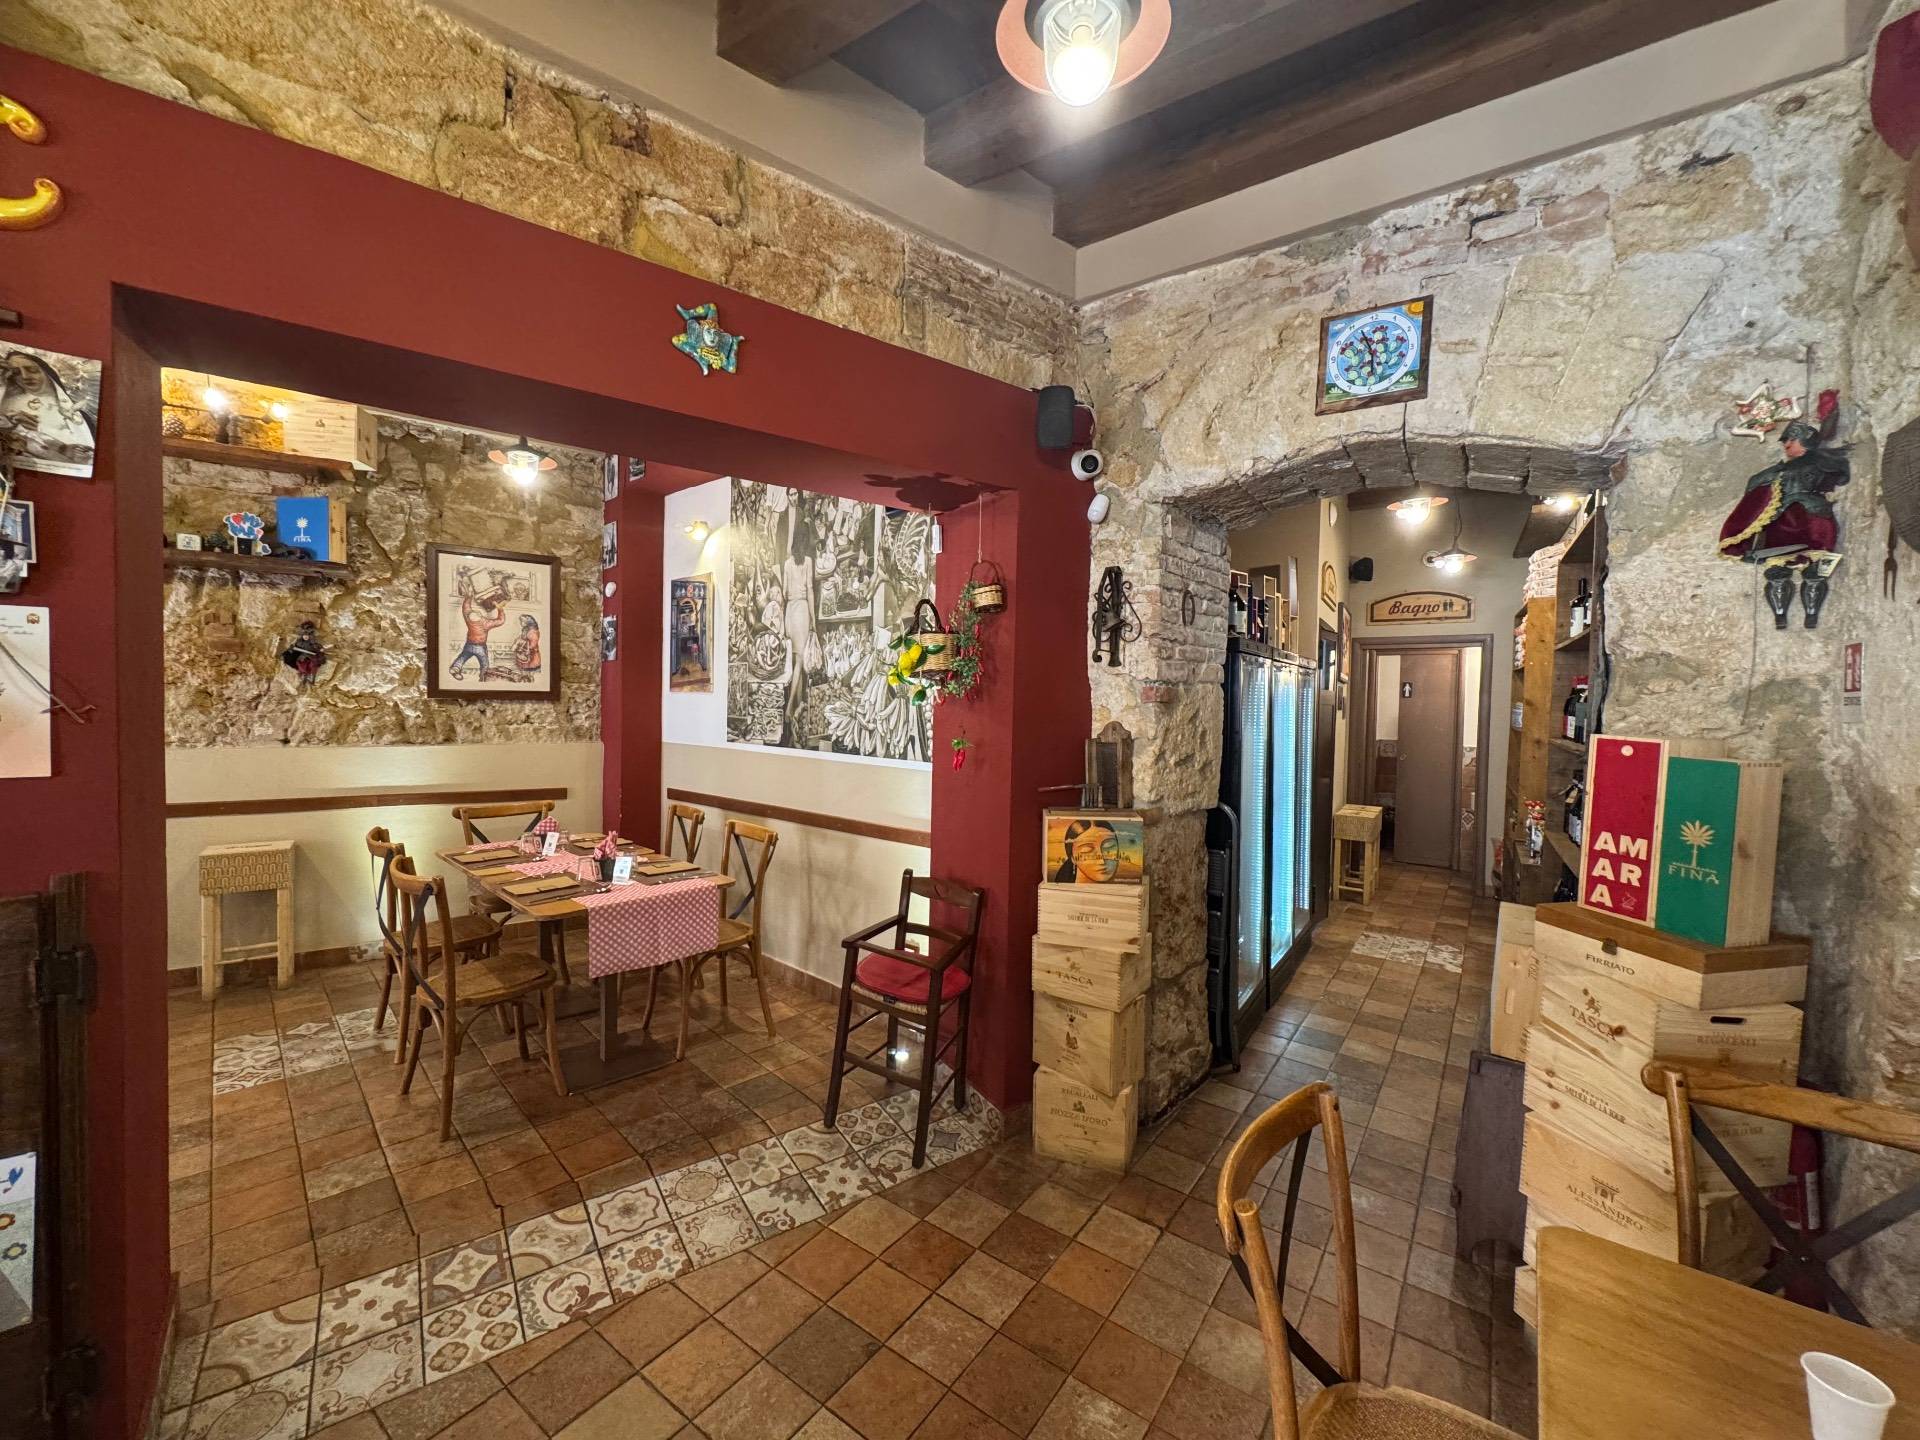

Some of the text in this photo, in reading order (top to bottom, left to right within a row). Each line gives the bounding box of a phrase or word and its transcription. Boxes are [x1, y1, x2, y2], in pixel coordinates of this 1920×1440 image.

[1388, 600, 1440, 617] Bagno
[1668, 864, 1721, 885] FINA
[1585, 953, 1636, 976] FIRRIATO
[1056, 970, 1094, 986] TASCA
[1569, 1005, 1617, 1041] TASCA
[1566, 1184, 1644, 1231] ALESSANDRO
